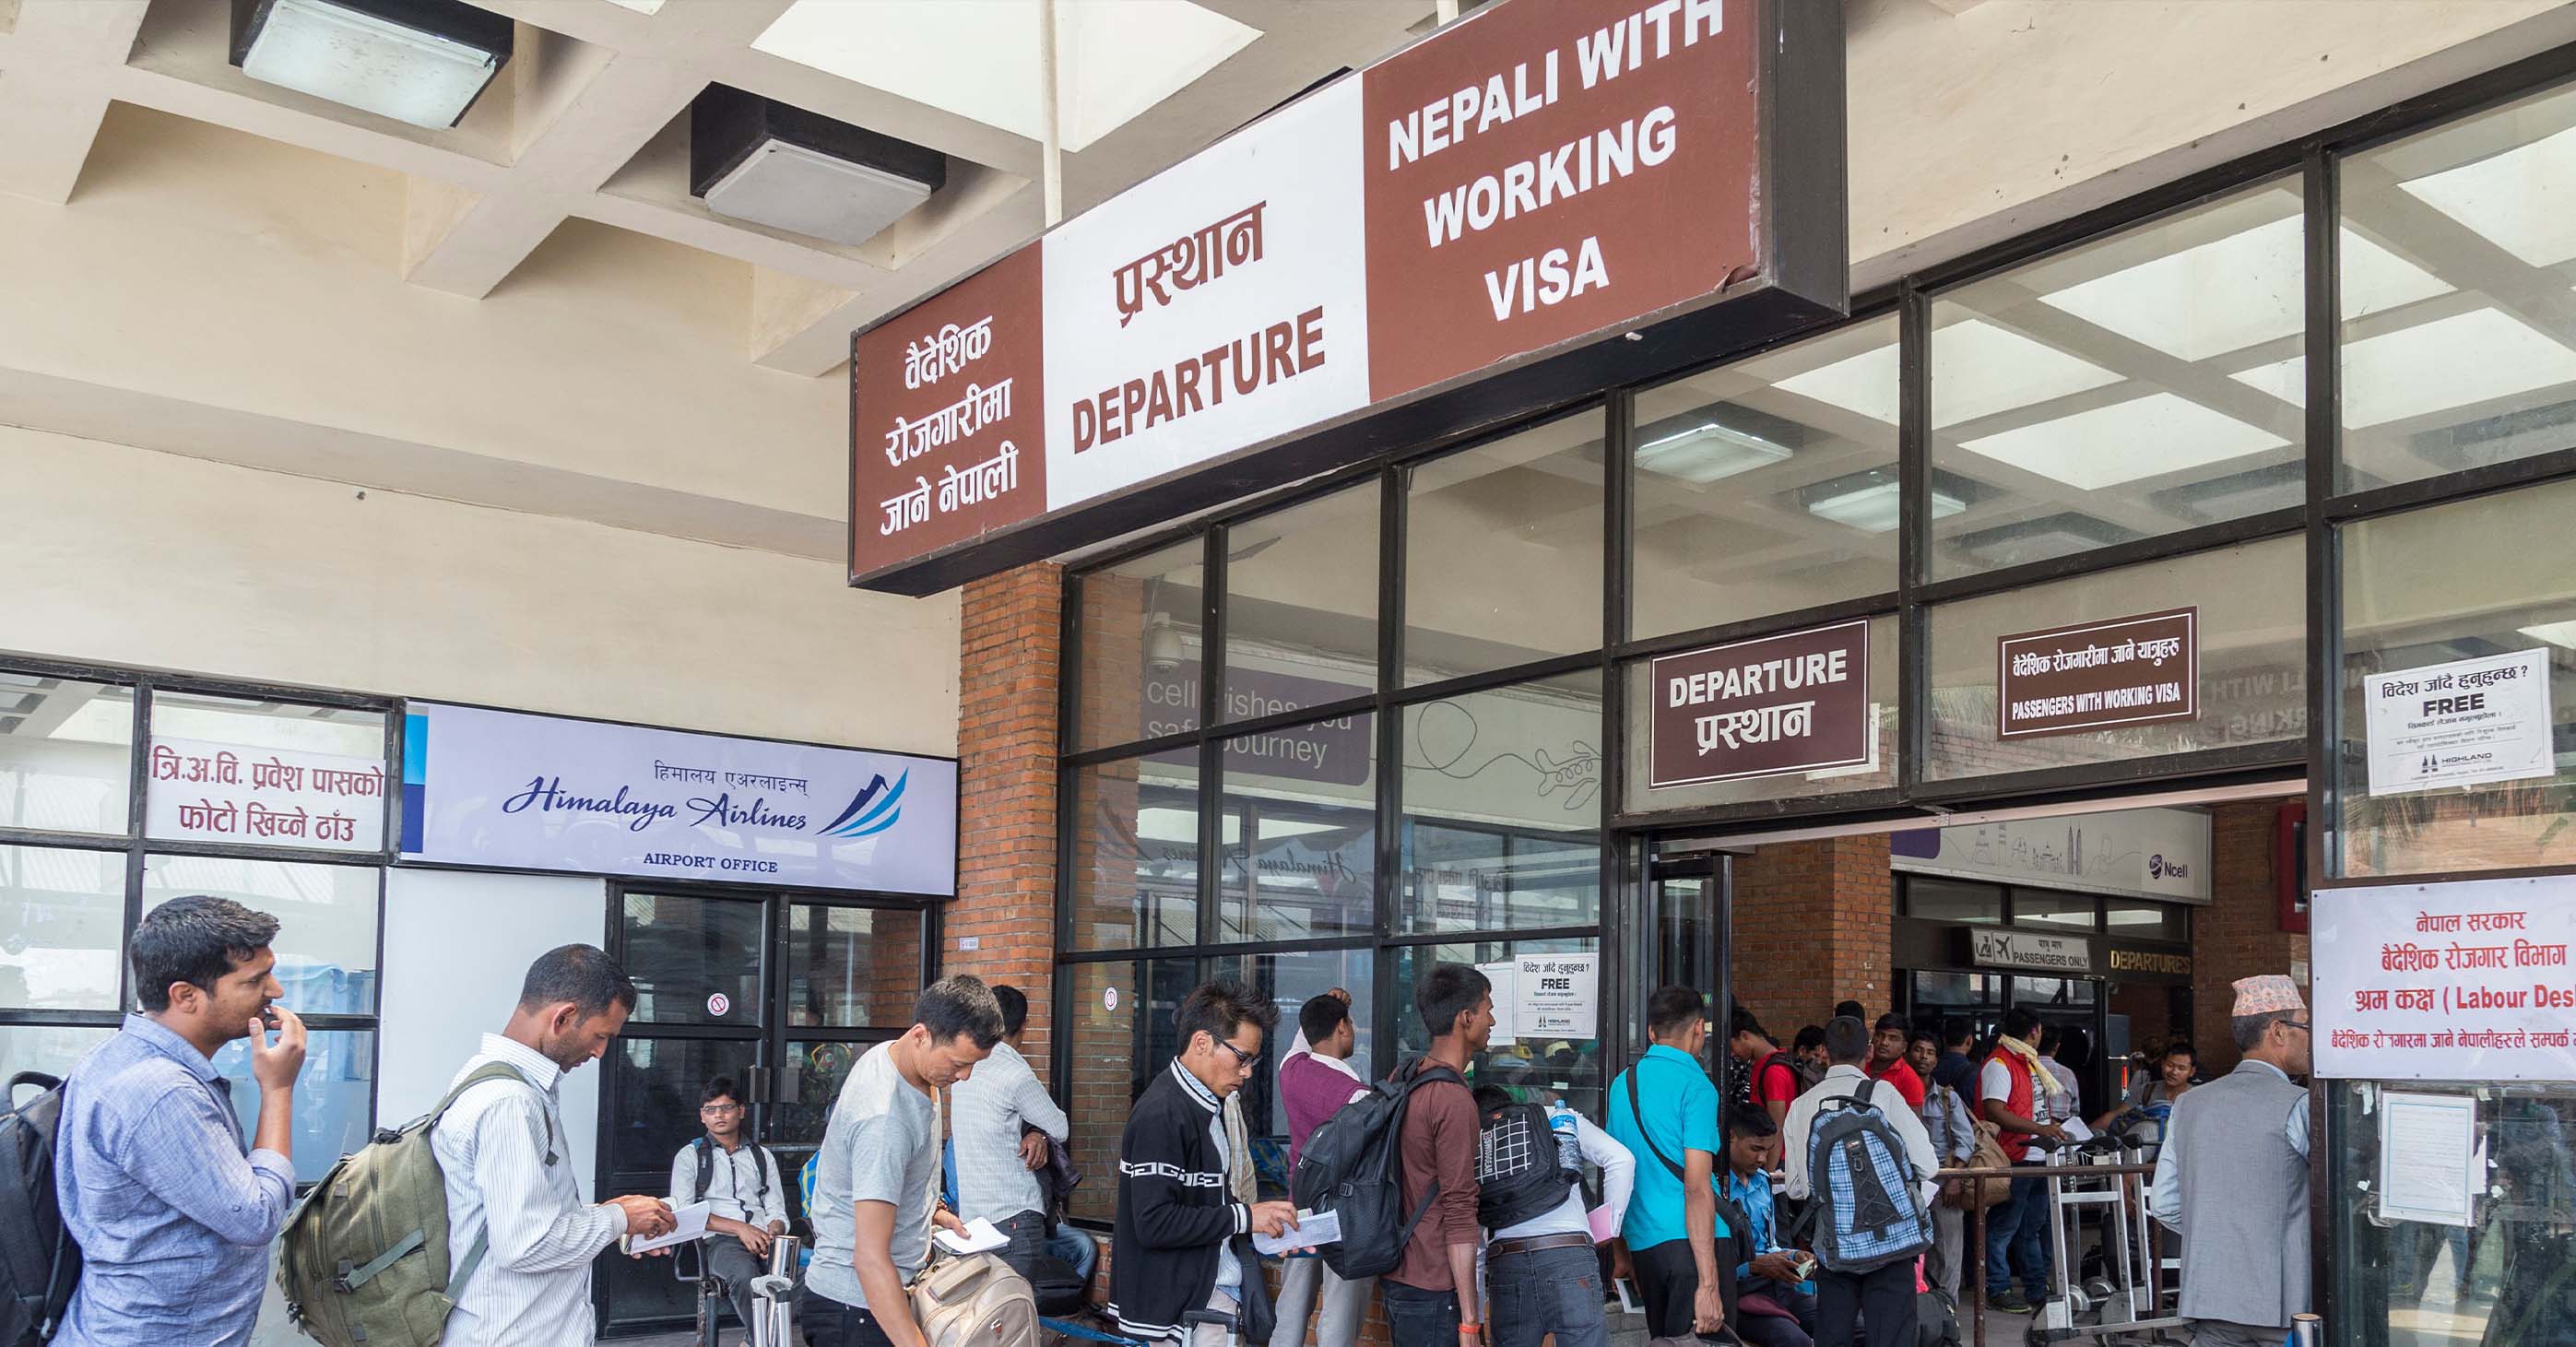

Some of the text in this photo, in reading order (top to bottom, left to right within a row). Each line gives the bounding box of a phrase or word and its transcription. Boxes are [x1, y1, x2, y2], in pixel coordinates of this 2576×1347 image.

[1388, 0, 1723, 171] NEPALI WITH
[1423, 105, 1676, 248] WORKING
[1113, 200, 1267, 328] प्रस्थान
[1484, 235, 1610, 322] VISA
[904, 315, 993, 390] वैदेशिक
[1072, 305, 1325, 455] DEPARTURE
[885, 377, 1013, 467] रोजगारीमा
[880, 440, 1019, 536] जाने नेपाली
[2013, 652, 2051, 677] वैदेशिक
[2052, 644, 2109, 672] रोजगारीमा
[2110, 639, 2135, 664] जाने
[1670, 649, 1848, 708] DEPARTURE
[2382, 680, 2419, 699] विदेश
[2458, 666, 2518, 691] हुनुहुन्छ
[2521, 665, 2528, 678] ?
[1224, 687, 1298, 716] ishes
[2012, 682, 2181, 721] PASSENGERS WITH WORKING VISA
[2423, 692, 2485, 717] FREE
[1695, 701, 1815, 757] प्रस्थान
[152, 745, 384, 798] त्रि.अ.वि. प्रवेश पासको
[654, 760, 715, 785] हिमालय
[2441, 751, 2493, 764] HIGHLAND
[179, 798, 357, 842] फोटो खिच्ने ठाँउ
[502, 775, 807, 832] Himalaya Airlines
[644, 852, 778, 873] AIRPORT OFFICE
[2165, 861, 2188, 878] Ncell
[2416, 911, 2527, 933] नेपाल सरकार
[2014, 951, 2088, 968] PASSENGERS ONLY
[2110, 950, 2191, 975] DEPARTURES
[2381, 939, 2568, 973] बैदेशिक रोजगार विभाग
[1542, 978, 1570, 989] FREE
[2356, 989, 2389, 1012] श्रम
[2395, 988, 2435, 1012] कक्ष
[2456, 986, 2527, 1010] Labour
[2535, 984, 2576, 1009] Des
[2332, 1029, 2369, 1049] बैदेशिक
[2430, 1028, 2454, 1048] जाने
[2530, 1028, 2570, 1048] सम्पर्क
